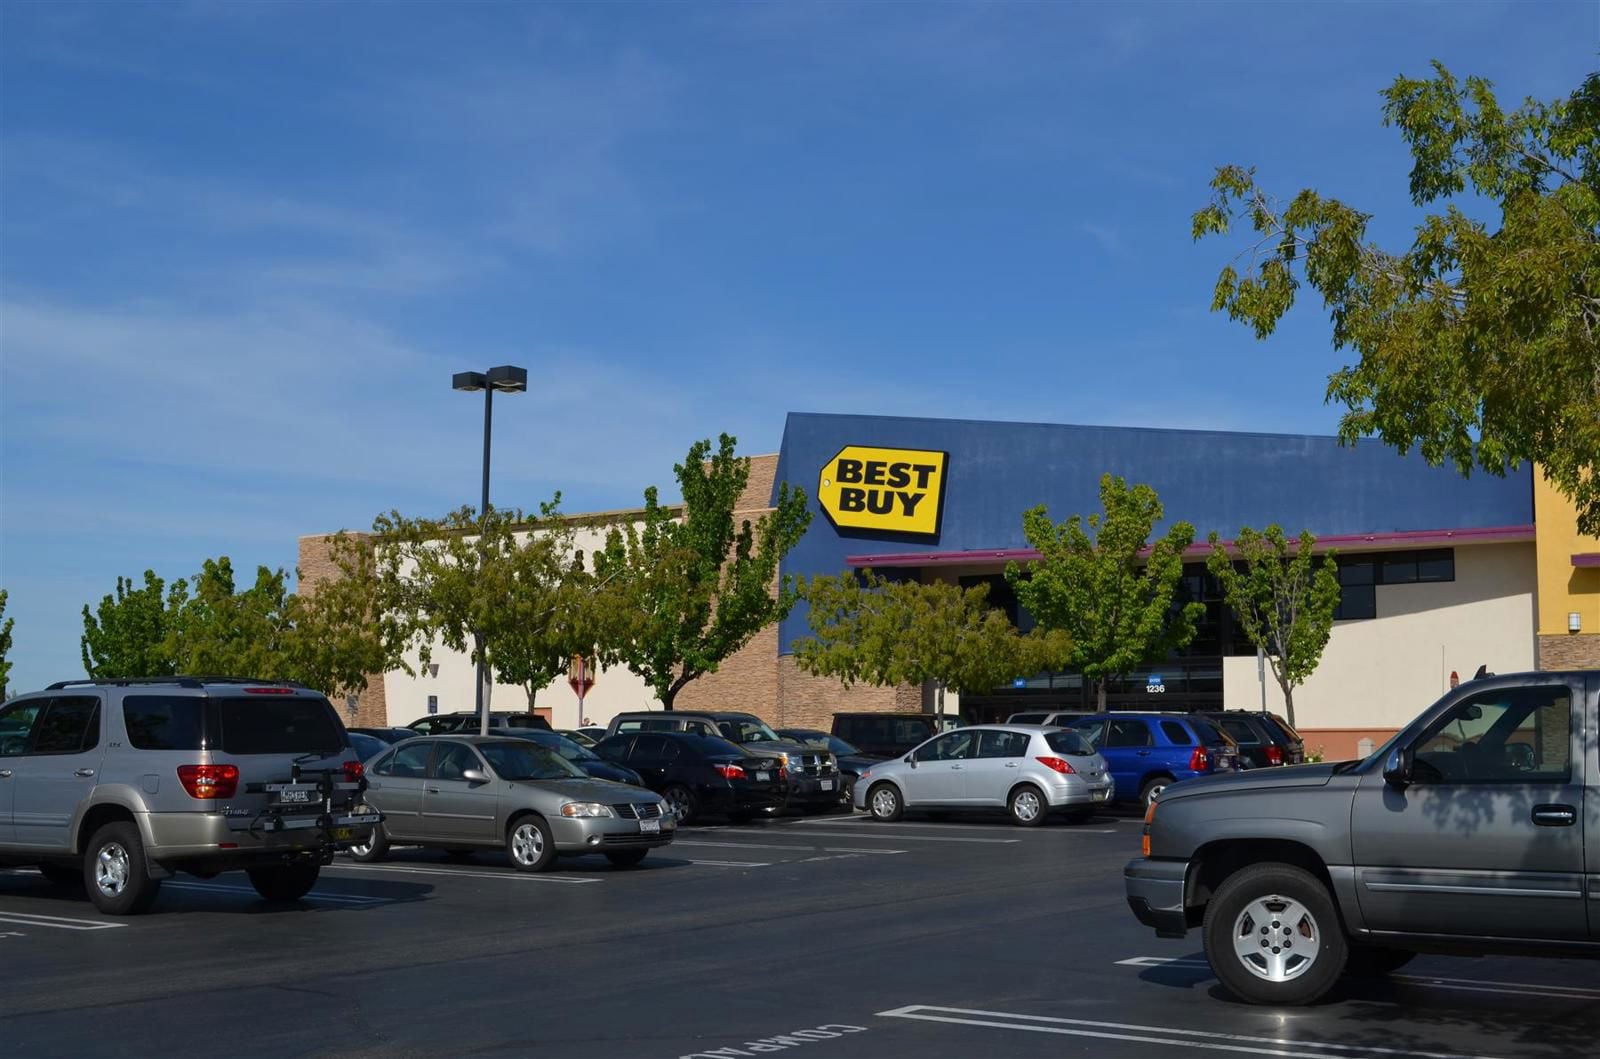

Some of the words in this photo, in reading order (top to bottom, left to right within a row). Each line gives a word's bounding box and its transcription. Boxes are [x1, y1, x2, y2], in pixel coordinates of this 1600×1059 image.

[836, 459, 937, 489] BEST
[839, 487, 926, 517] BUY
[1146, 684, 1165, 693] 1236
